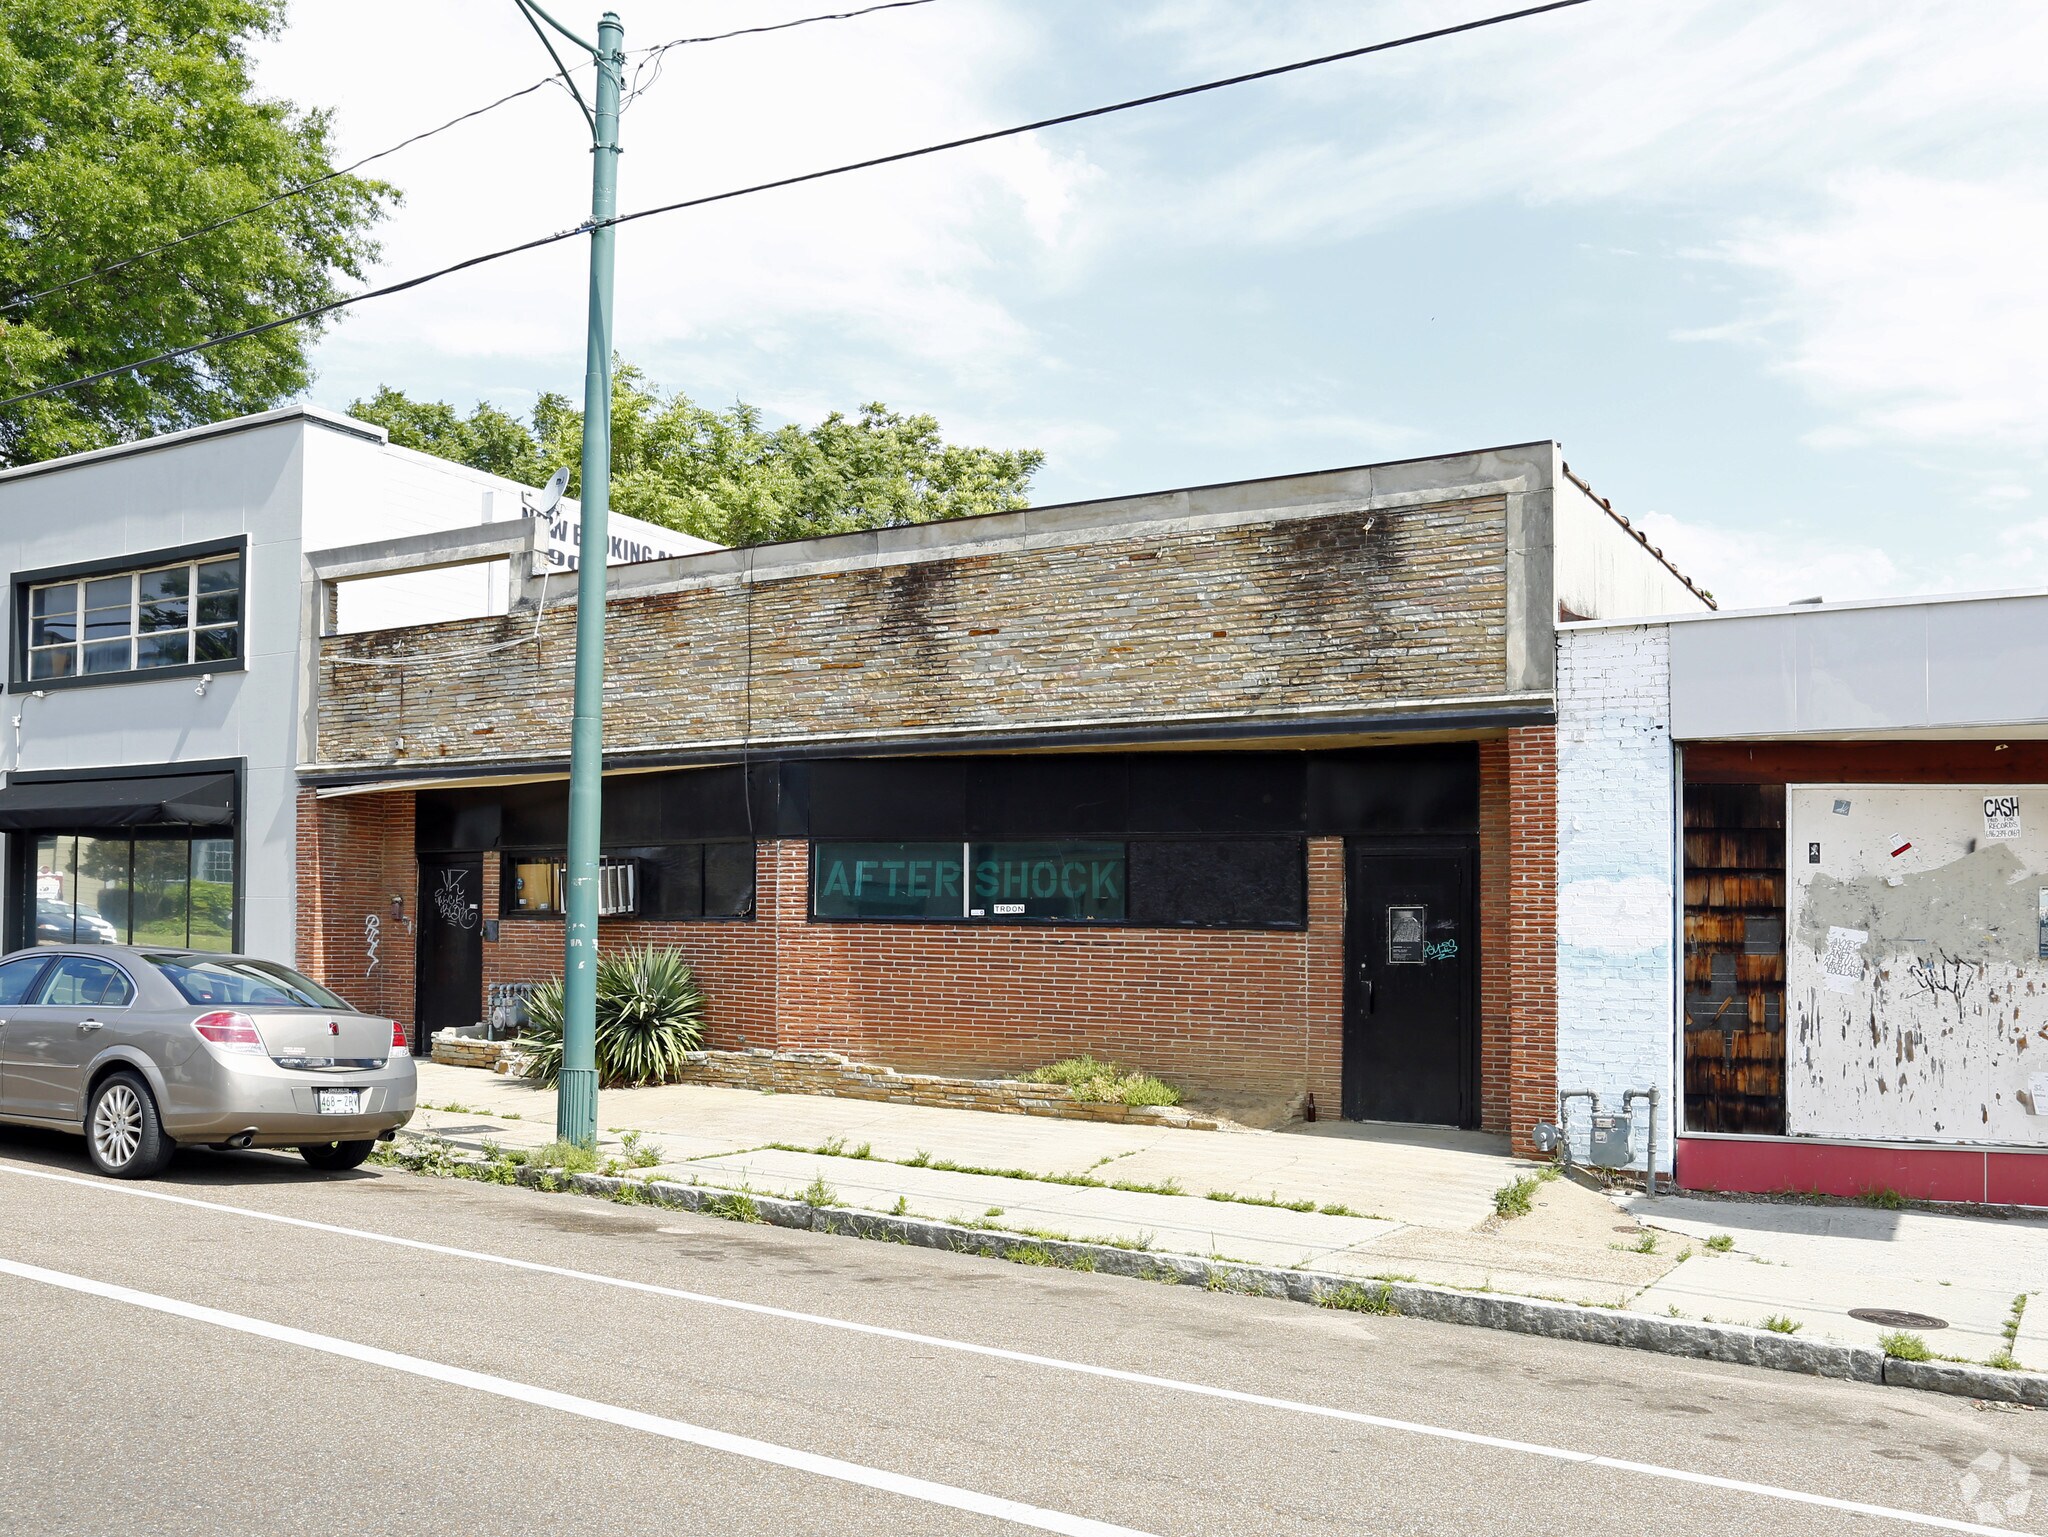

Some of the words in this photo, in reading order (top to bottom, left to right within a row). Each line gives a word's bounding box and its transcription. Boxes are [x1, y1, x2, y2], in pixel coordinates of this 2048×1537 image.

[573, 523, 652, 563] BKING
[1984, 797, 2020, 817] CASH
[1988, 821, 2018, 829] RECORDS
[823, 861, 962, 897] AFTER
[974, 861, 1120, 898] SHOCK
